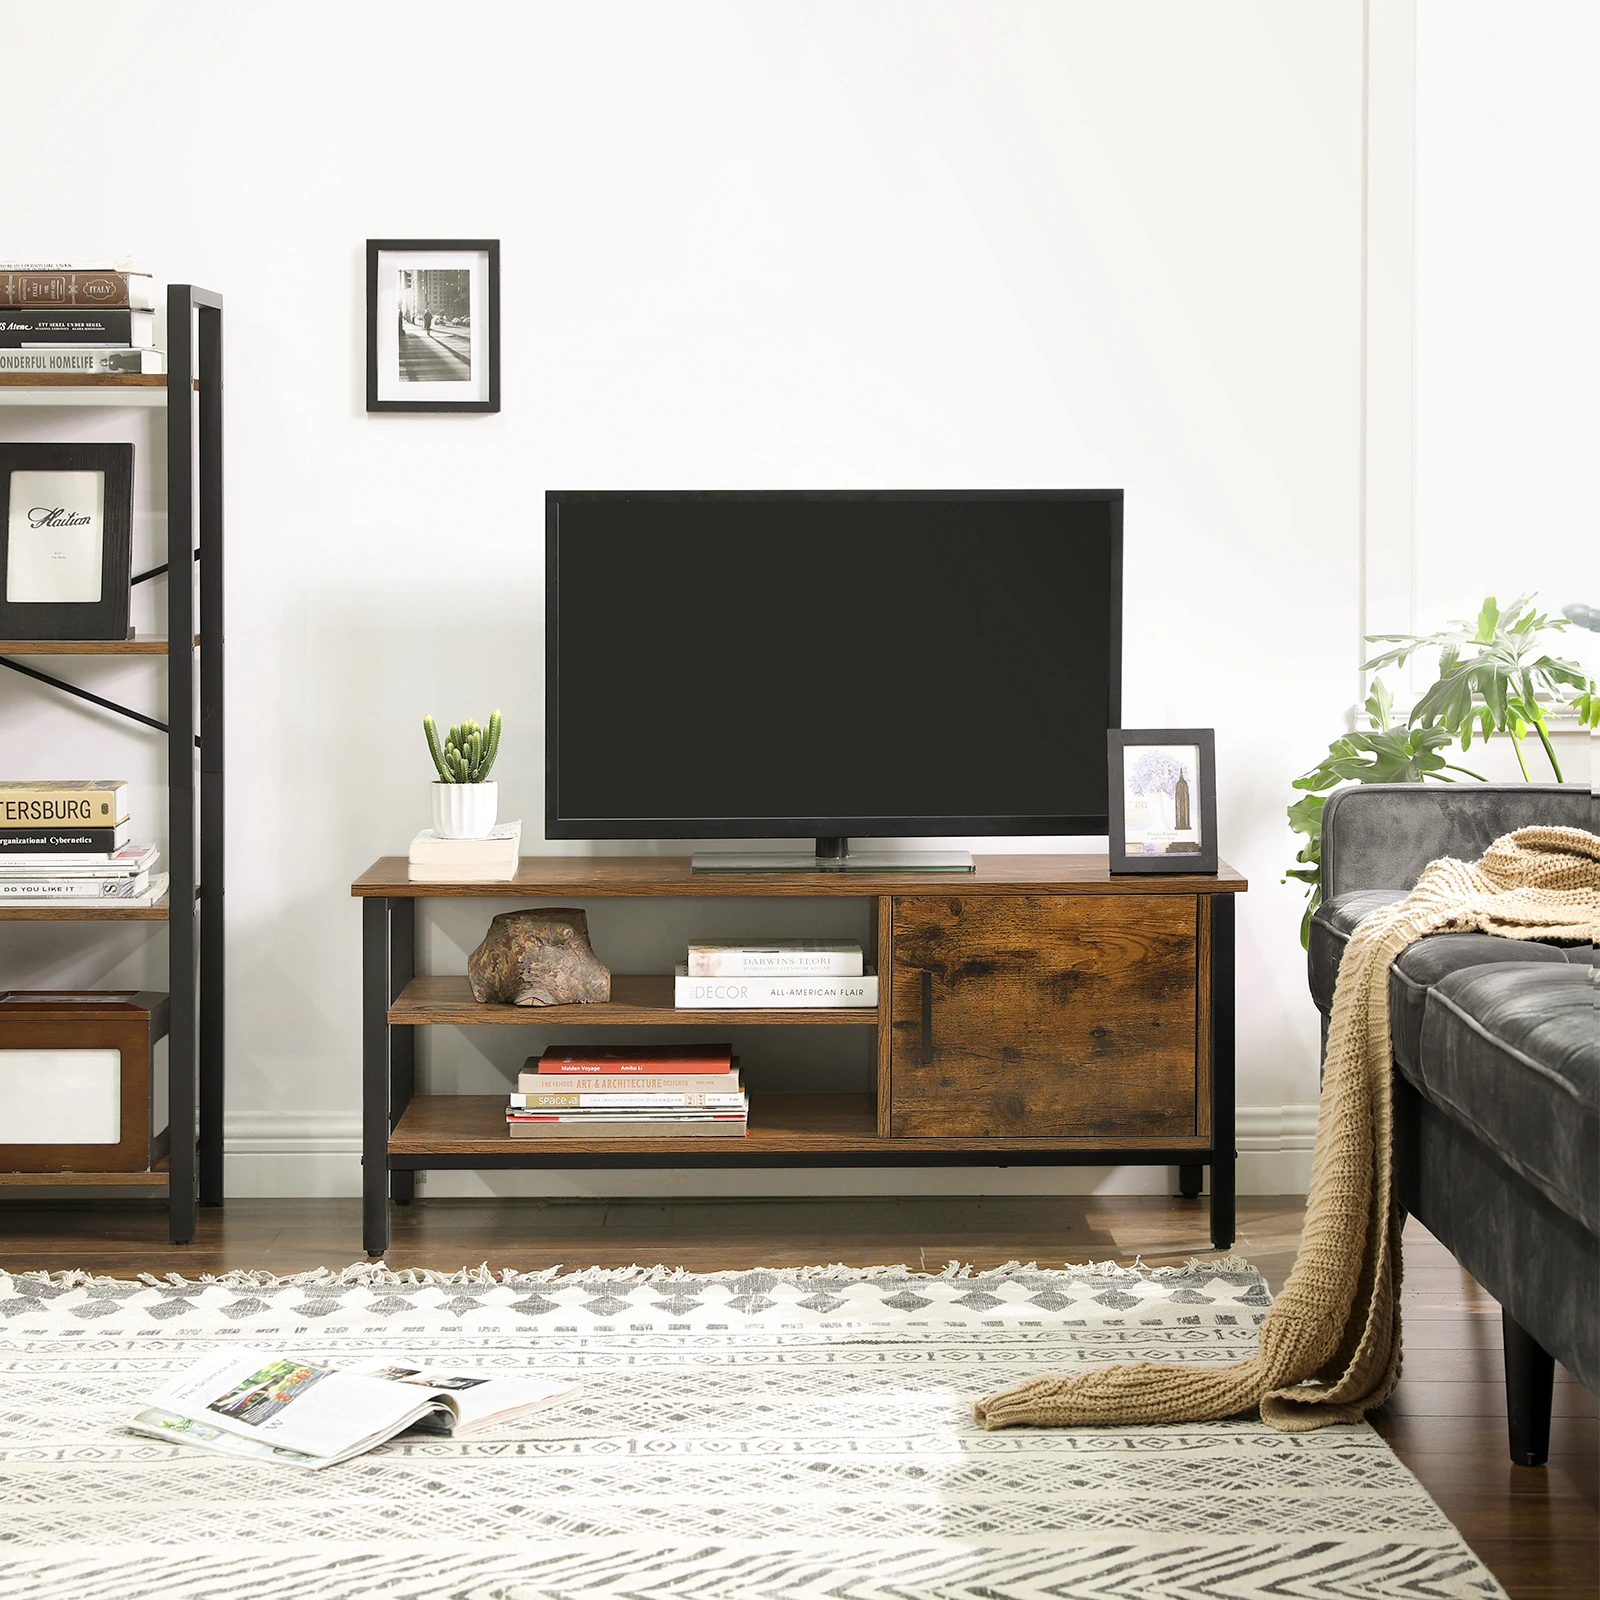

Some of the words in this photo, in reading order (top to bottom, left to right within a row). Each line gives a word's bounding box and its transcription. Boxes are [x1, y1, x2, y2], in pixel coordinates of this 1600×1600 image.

[6, 322, 33, 330] Atene
[50, 356, 94, 369] HOMELIFE
[50, 836, 92, 846] Cybernetics
[696, 986, 748, 999] DECOR
[770, 988, 836, 996] ALL-AMERICAN
[840, 988, 864, 996] FLAIR
[576, 1080, 591, 1088] ART
[594, 1080, 600, 1088] &
[602, 1079, 662, 1088] ARCHITECTURE
